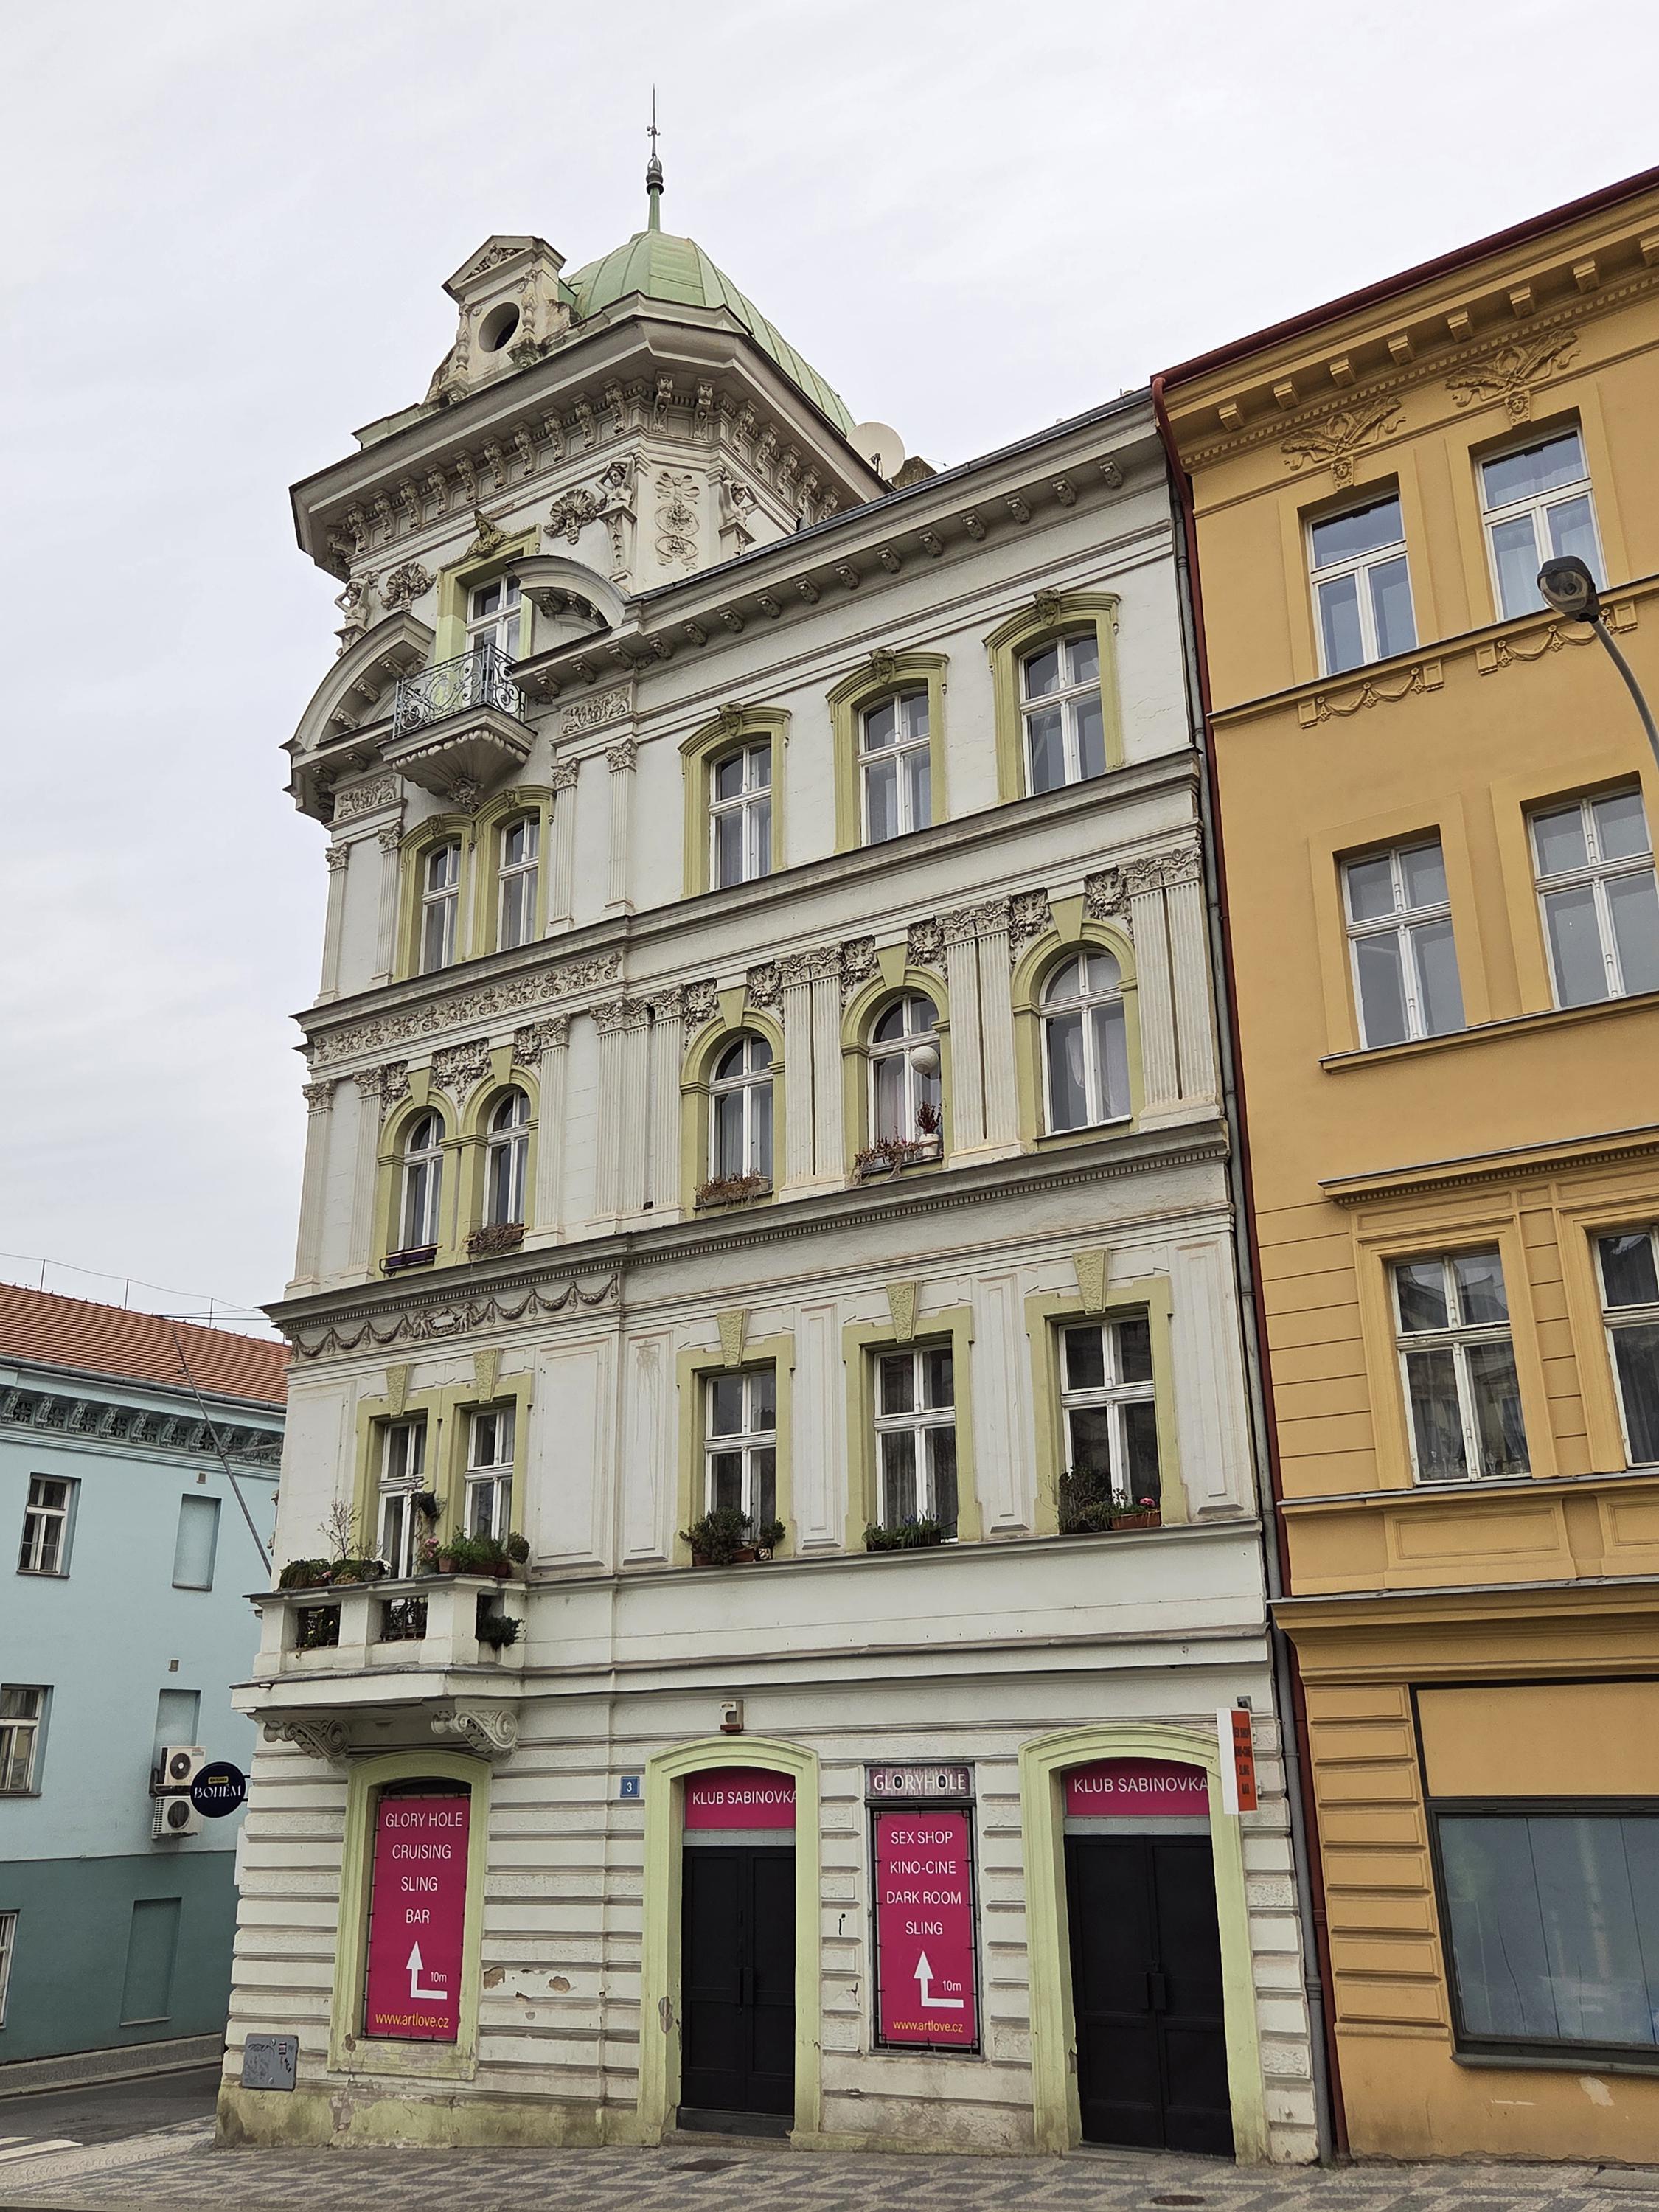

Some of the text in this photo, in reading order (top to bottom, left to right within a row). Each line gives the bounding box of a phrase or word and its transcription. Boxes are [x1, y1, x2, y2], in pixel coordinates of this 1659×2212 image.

[626, 1781, 633, 1792] 3
[874, 1773, 966, 1790] GLORYHOLE
[1074, 1776, 1208, 1793] KLUB SABINOVKA
[692, 1792, 724, 1805] KLUB
[385, 1812, 463, 1828] GLORY HOLE
[891, 1831, 953, 1845] SEX SHOP
[392, 1843, 451, 1860] CRUISING
[890, 1860, 956, 1874] KINO-CINE
[400, 1876, 438, 1892] SLING
[886, 1891, 961, 1905] DARK ROOM
[406, 1908, 430, 1924] BAR
[905, 1921, 943, 1935] SLING
[430, 1971, 448, 1983] 10m
[942, 1980, 962, 1992] 10m
[375, 2012, 450, 2028] www.artlove.cz
[893, 2019, 964, 2033] www.artlove.cz
